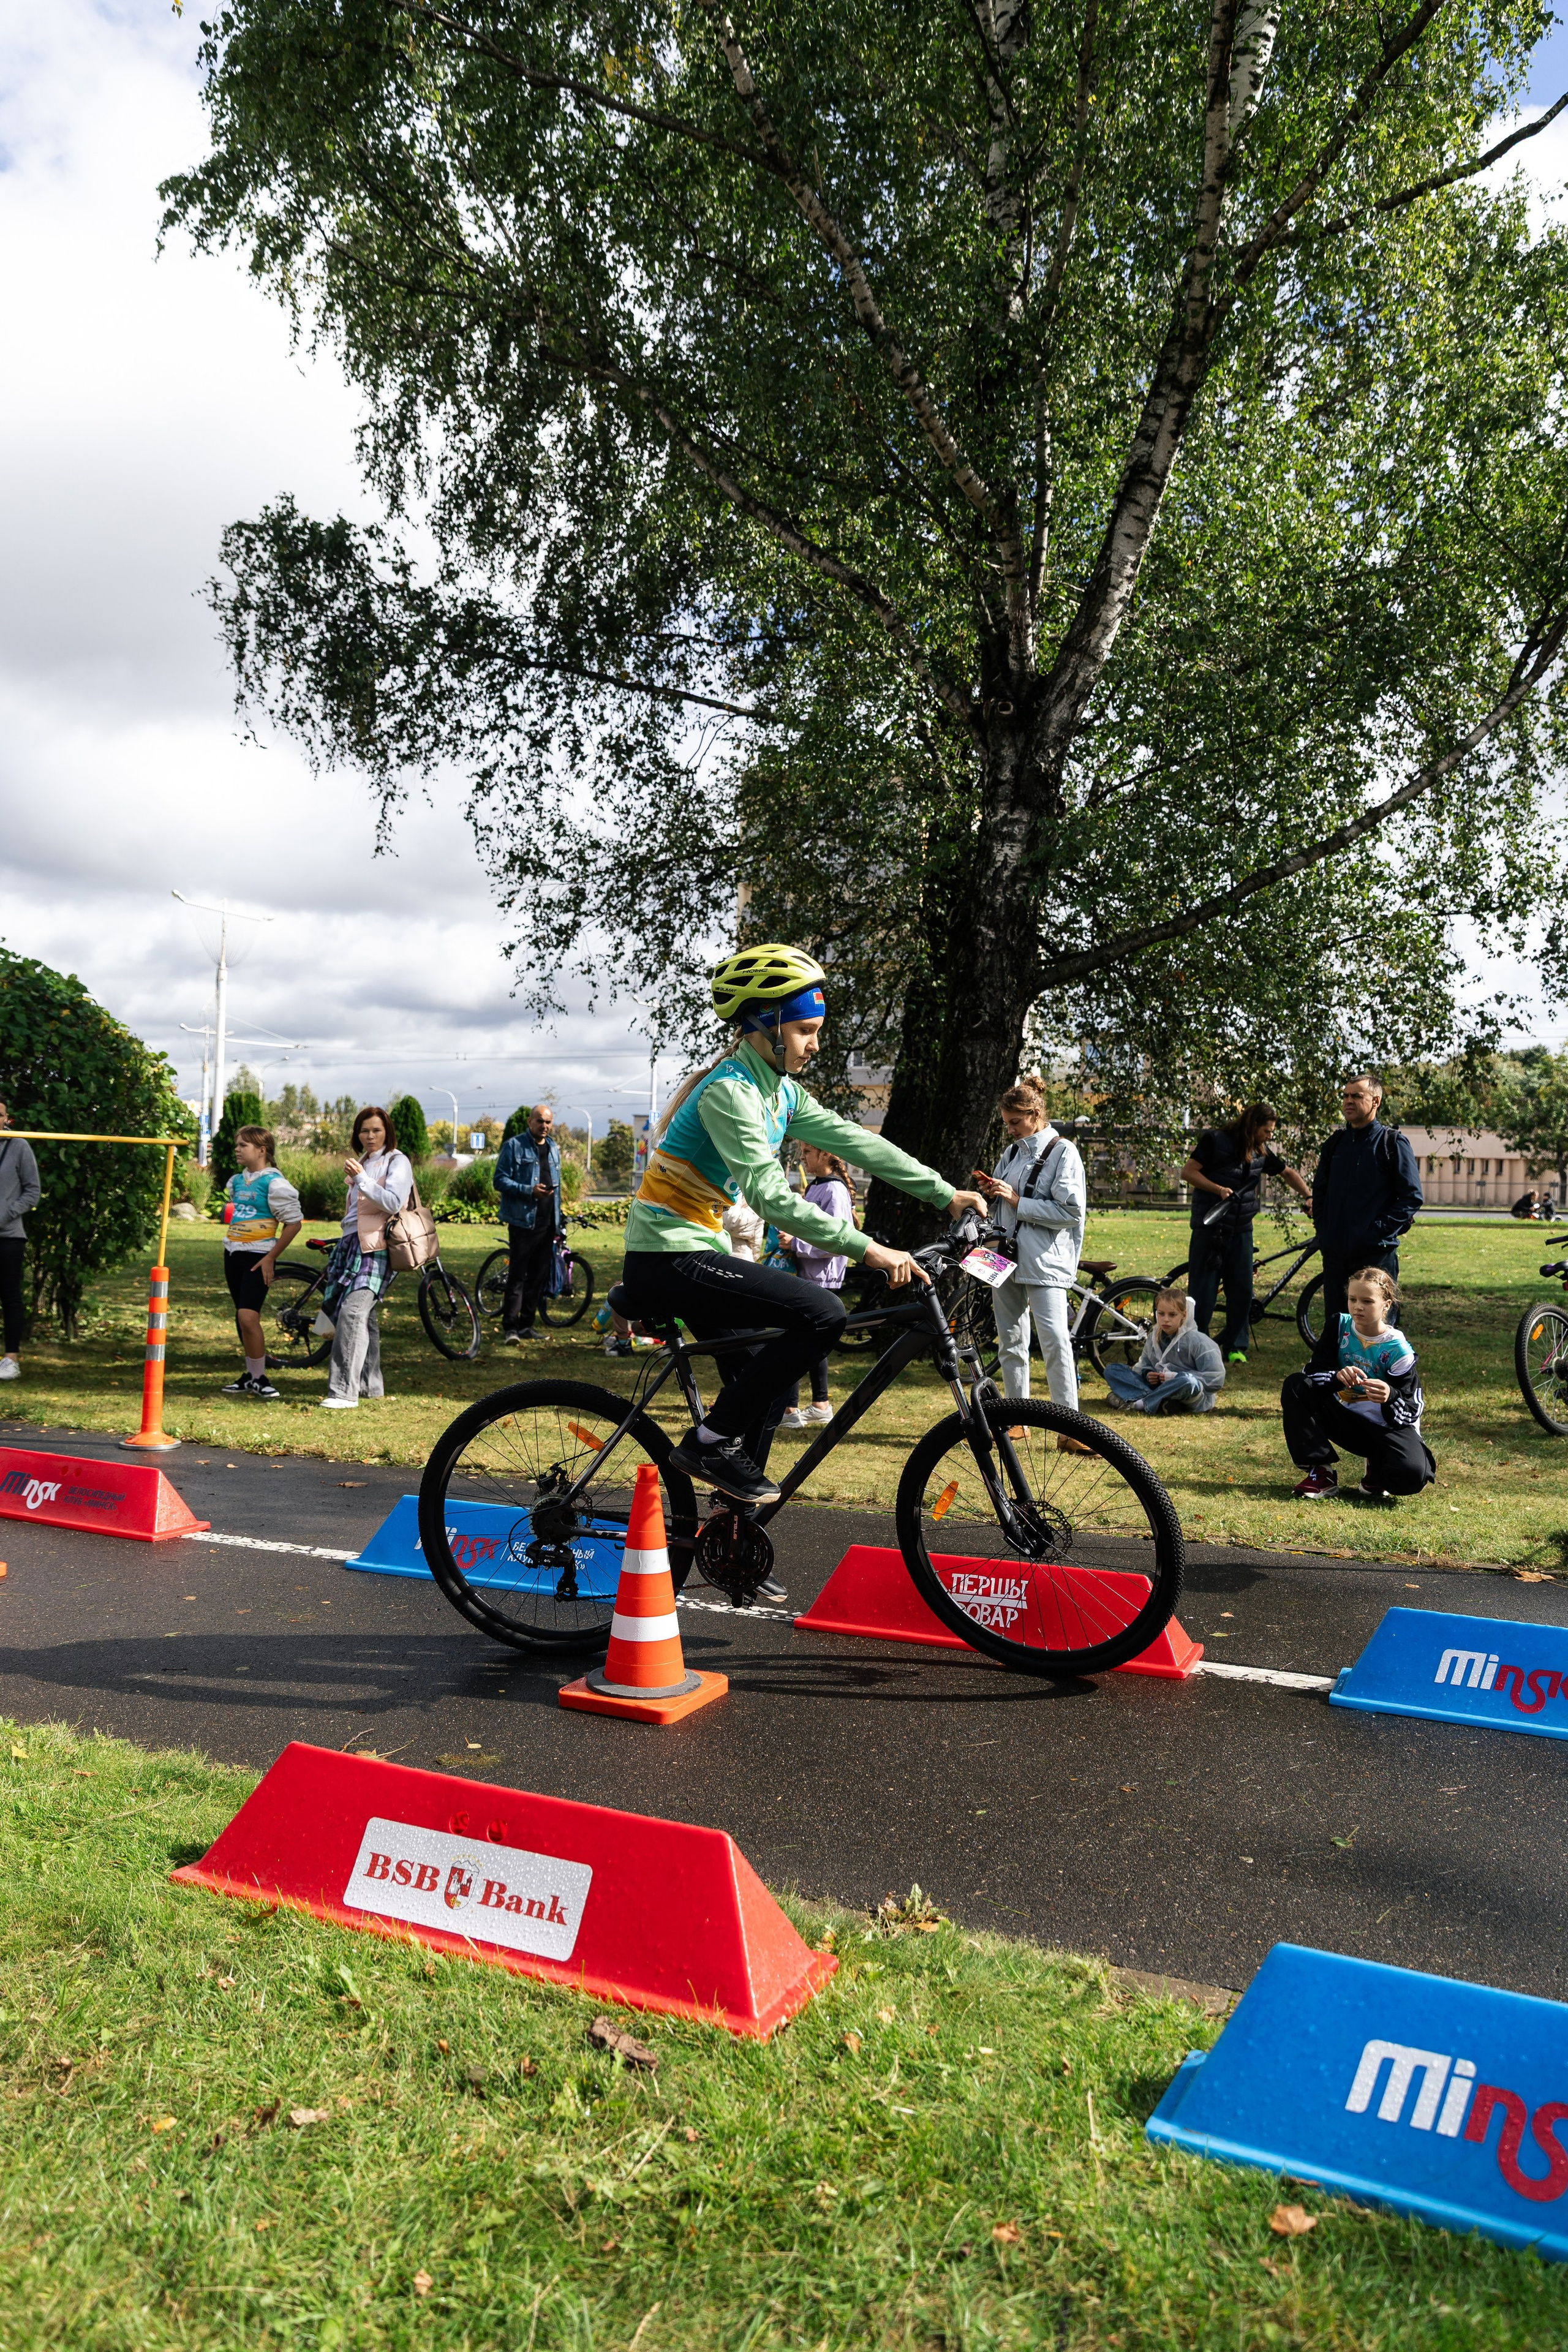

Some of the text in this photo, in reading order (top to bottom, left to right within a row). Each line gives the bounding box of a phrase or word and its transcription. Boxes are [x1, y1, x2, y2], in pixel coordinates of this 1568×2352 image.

[63, 1494, 118, 1511] КЛУБ «МИНСК»
[68, 1485, 126, 1502] ВЕЛОСИПЕДНЫЙ
[952, 1573, 1029, 1600] ПЕРШЫ
[363, 1852, 569, 1926] BSB Bank
